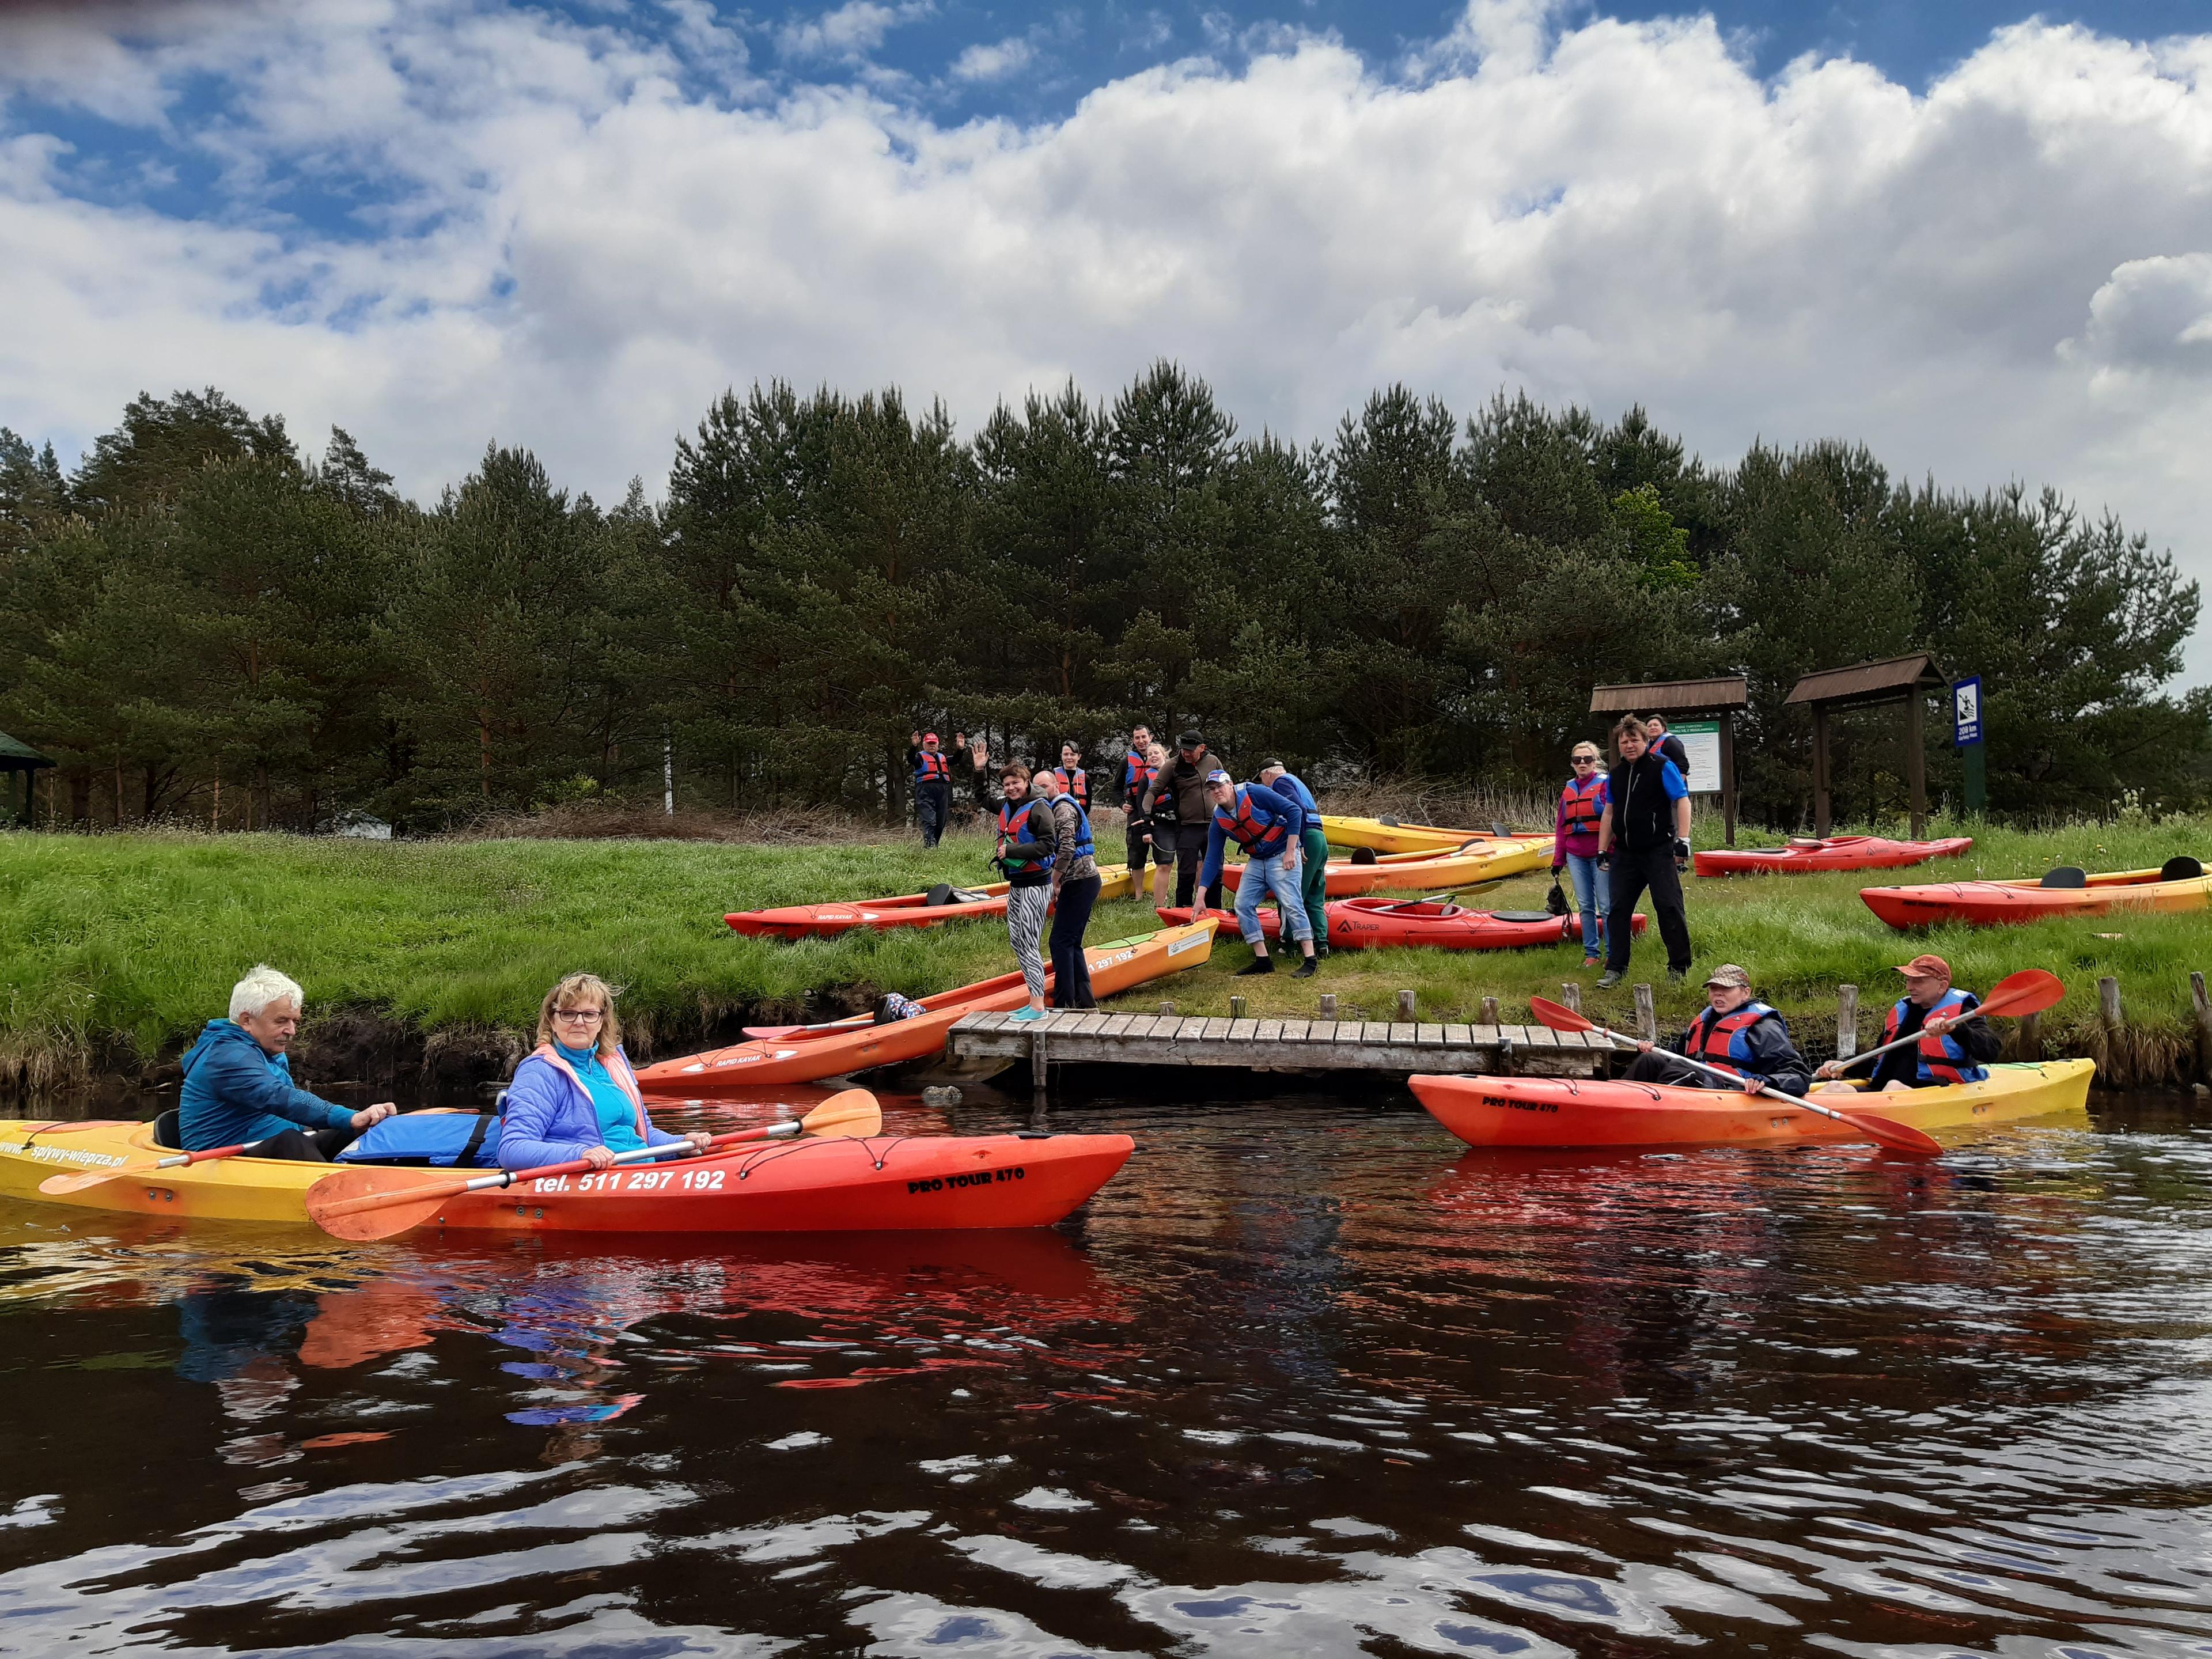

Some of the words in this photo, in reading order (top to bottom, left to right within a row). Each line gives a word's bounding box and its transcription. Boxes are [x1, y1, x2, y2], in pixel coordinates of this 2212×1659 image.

[1352, 921, 1380, 930] TRAPER
[1096, 957, 1113, 969] 297
[1115, 950, 1133, 962] 192
[716, 1058, 737, 1067] RAPID
[737, 1055, 762, 1063] KAYAK
[1482, 1096, 1506, 1107] PRO
[1509, 1099, 1538, 1111] TOUR
[1539, 1103, 1558, 1113] 470
[535, 1175, 570, 1192] tel.
[578, 1173, 623, 1191] 511
[627, 1171, 675, 1190] 297
[681, 1170, 726, 1190] 192
[907, 1179, 943, 1194] PRO
[945, 1172, 993, 1189] TOUR
[996, 1167, 1025, 1181] 470
